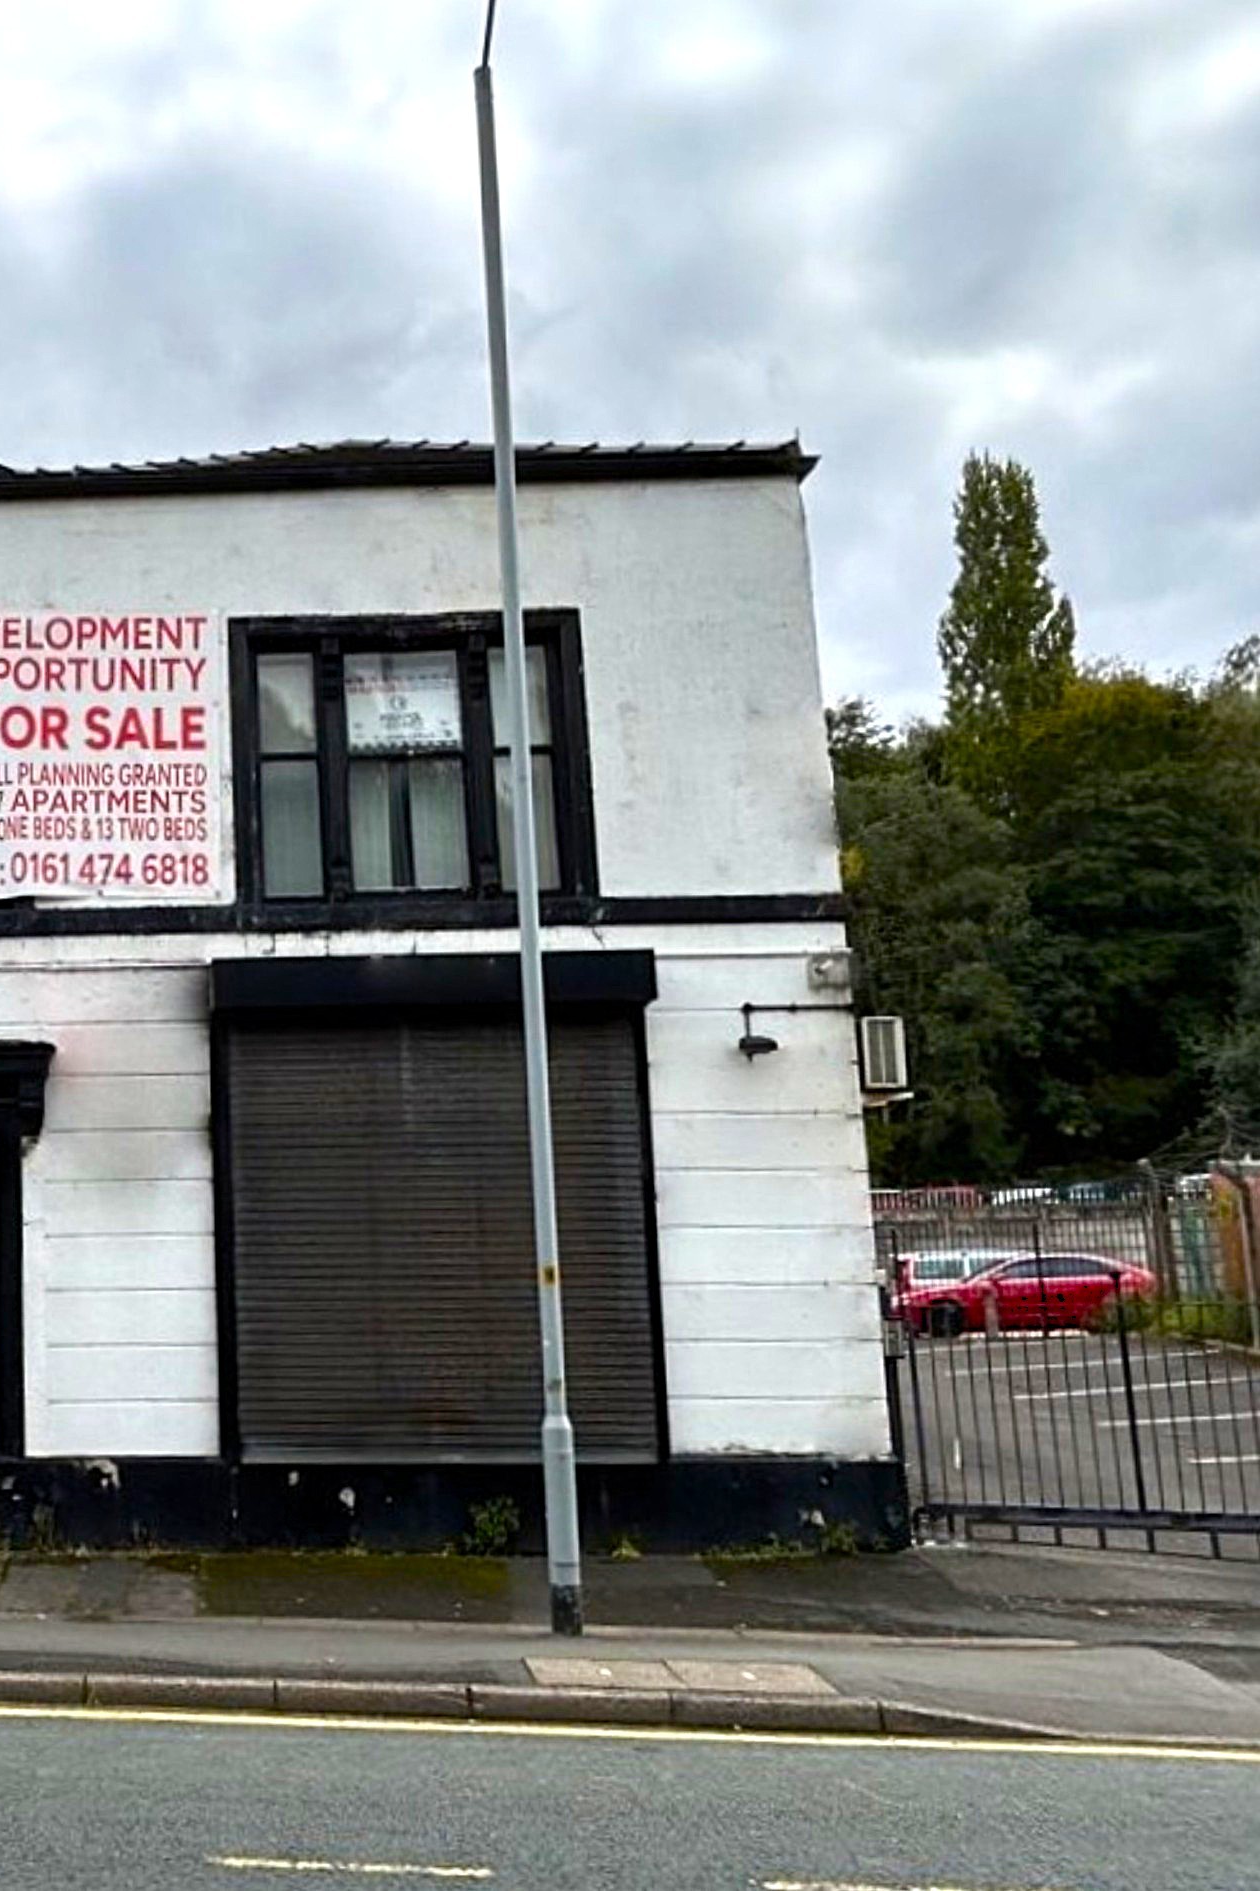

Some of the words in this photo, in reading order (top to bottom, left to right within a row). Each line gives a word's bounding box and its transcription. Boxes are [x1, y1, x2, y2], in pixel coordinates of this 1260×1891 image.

[84, 706, 207, 751] SALE
[17, 763, 115, 787] PLANNING
[119, 763, 208, 787] GRANTED
[10, 789, 207, 814] APARTMENTS
[32, 817, 77, 841] BEDS
[80, 817, 92, 841] &
[96, 818, 114, 840] 13
[118, 817, 160, 842] TWO
[163, 817, 208, 842] BEDS
[10, 851, 71, 885] 0161
[78, 852, 134, 886] 474
[141, 852, 209, 885] 6818
